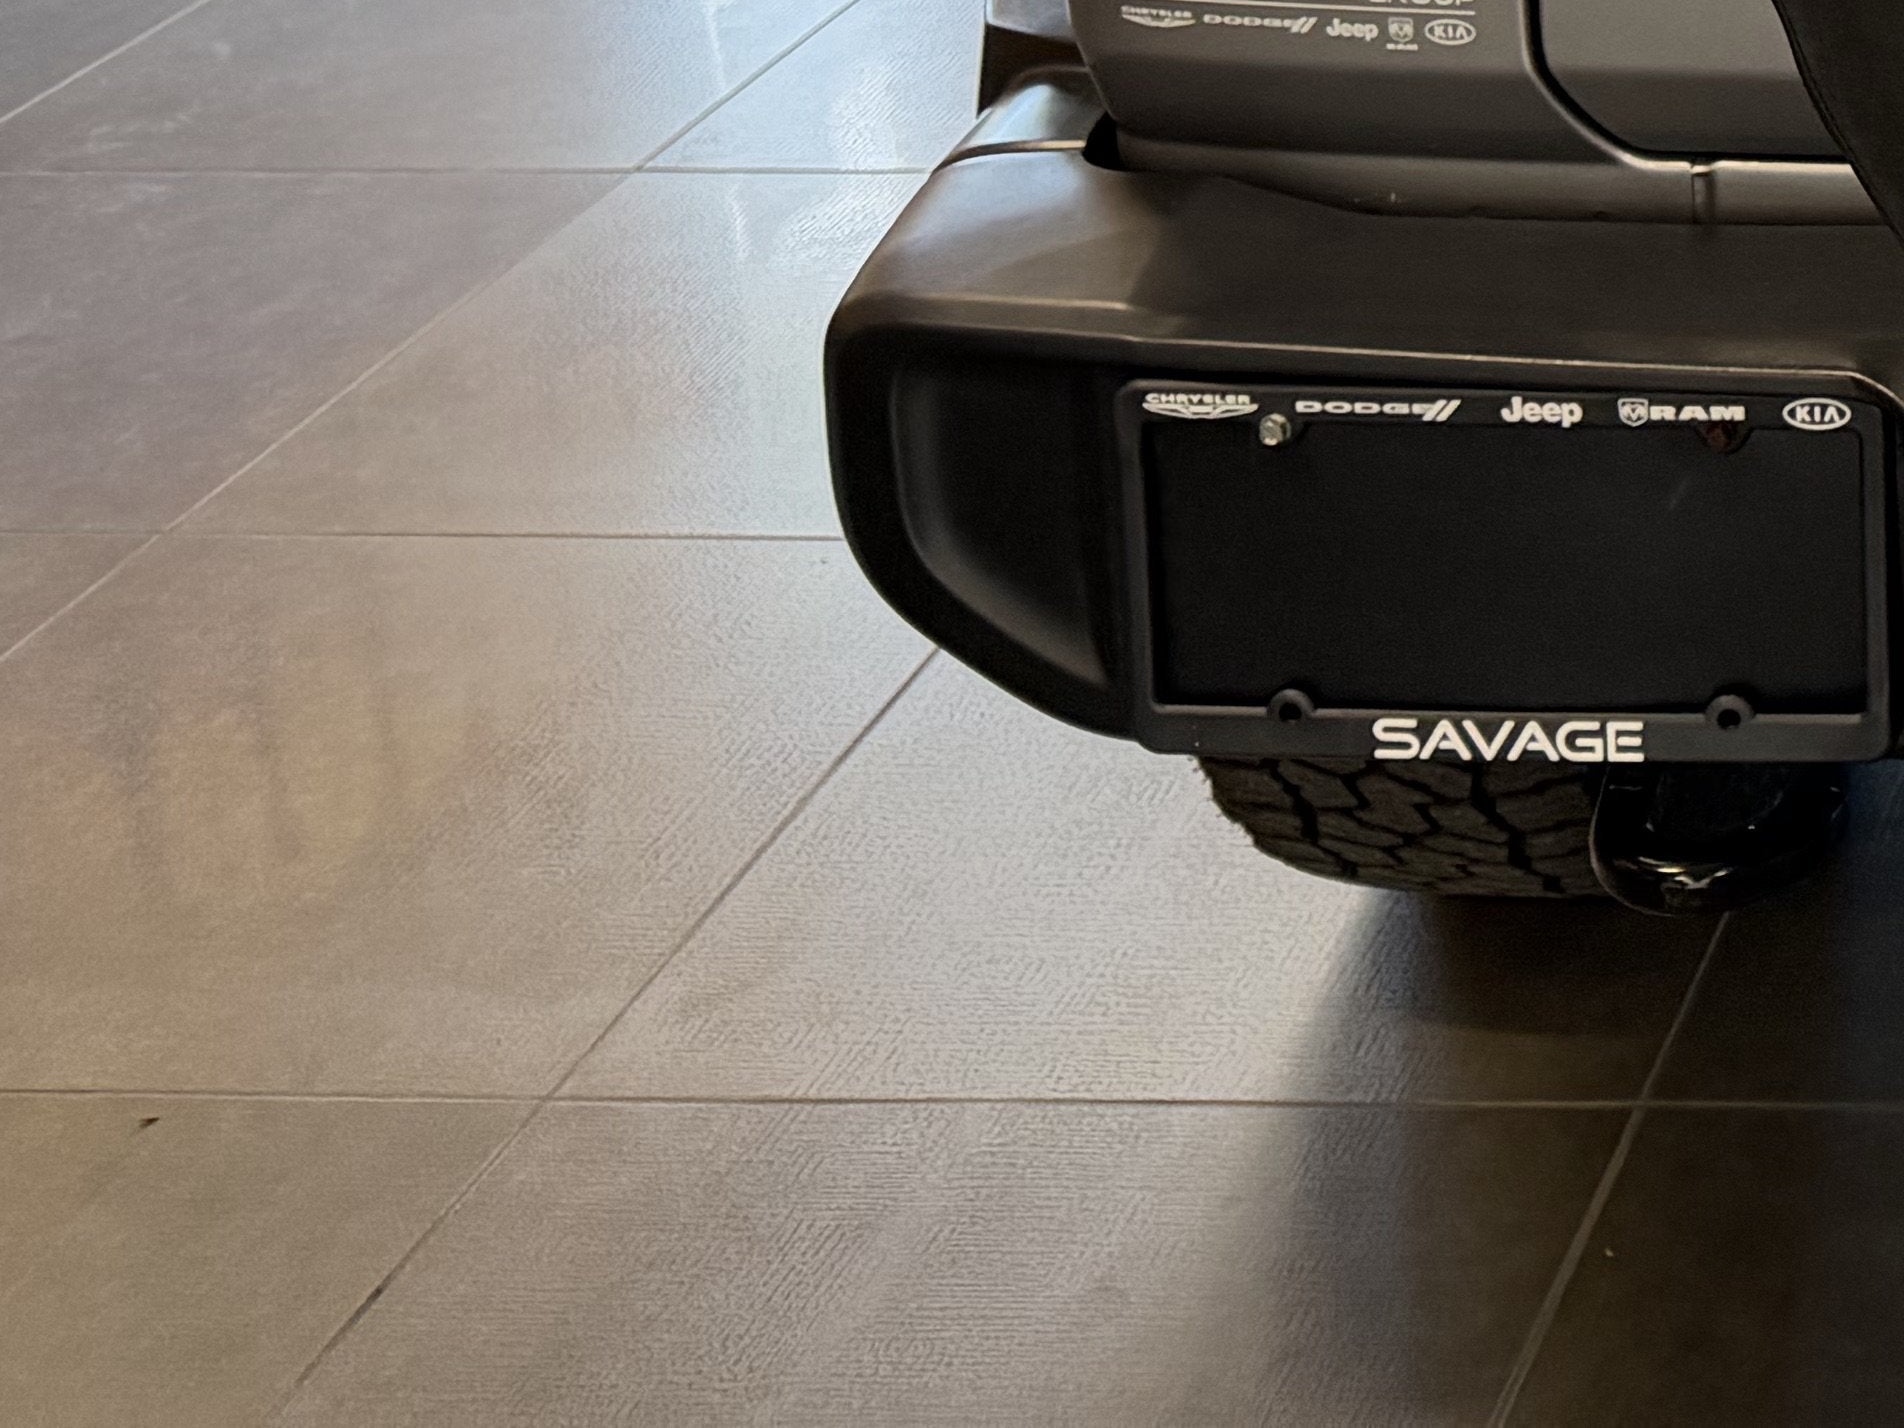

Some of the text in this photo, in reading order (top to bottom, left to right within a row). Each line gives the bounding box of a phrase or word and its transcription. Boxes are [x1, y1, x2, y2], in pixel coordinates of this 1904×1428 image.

[1203, 13, 1300, 29] DODGE
[1326, 17, 1379, 42] Jeep
[1433, 24, 1468, 42] KIA
[1145, 392, 1251, 405] CHRYSLER
[1295, 400, 1434, 415] DODGE
[1501, 396, 1583, 428] Jeep
[1650, 405, 1746, 421] RAM
[1795, 404, 1840, 423] KIA
[1372, 718, 1645, 763] SAVAGE
